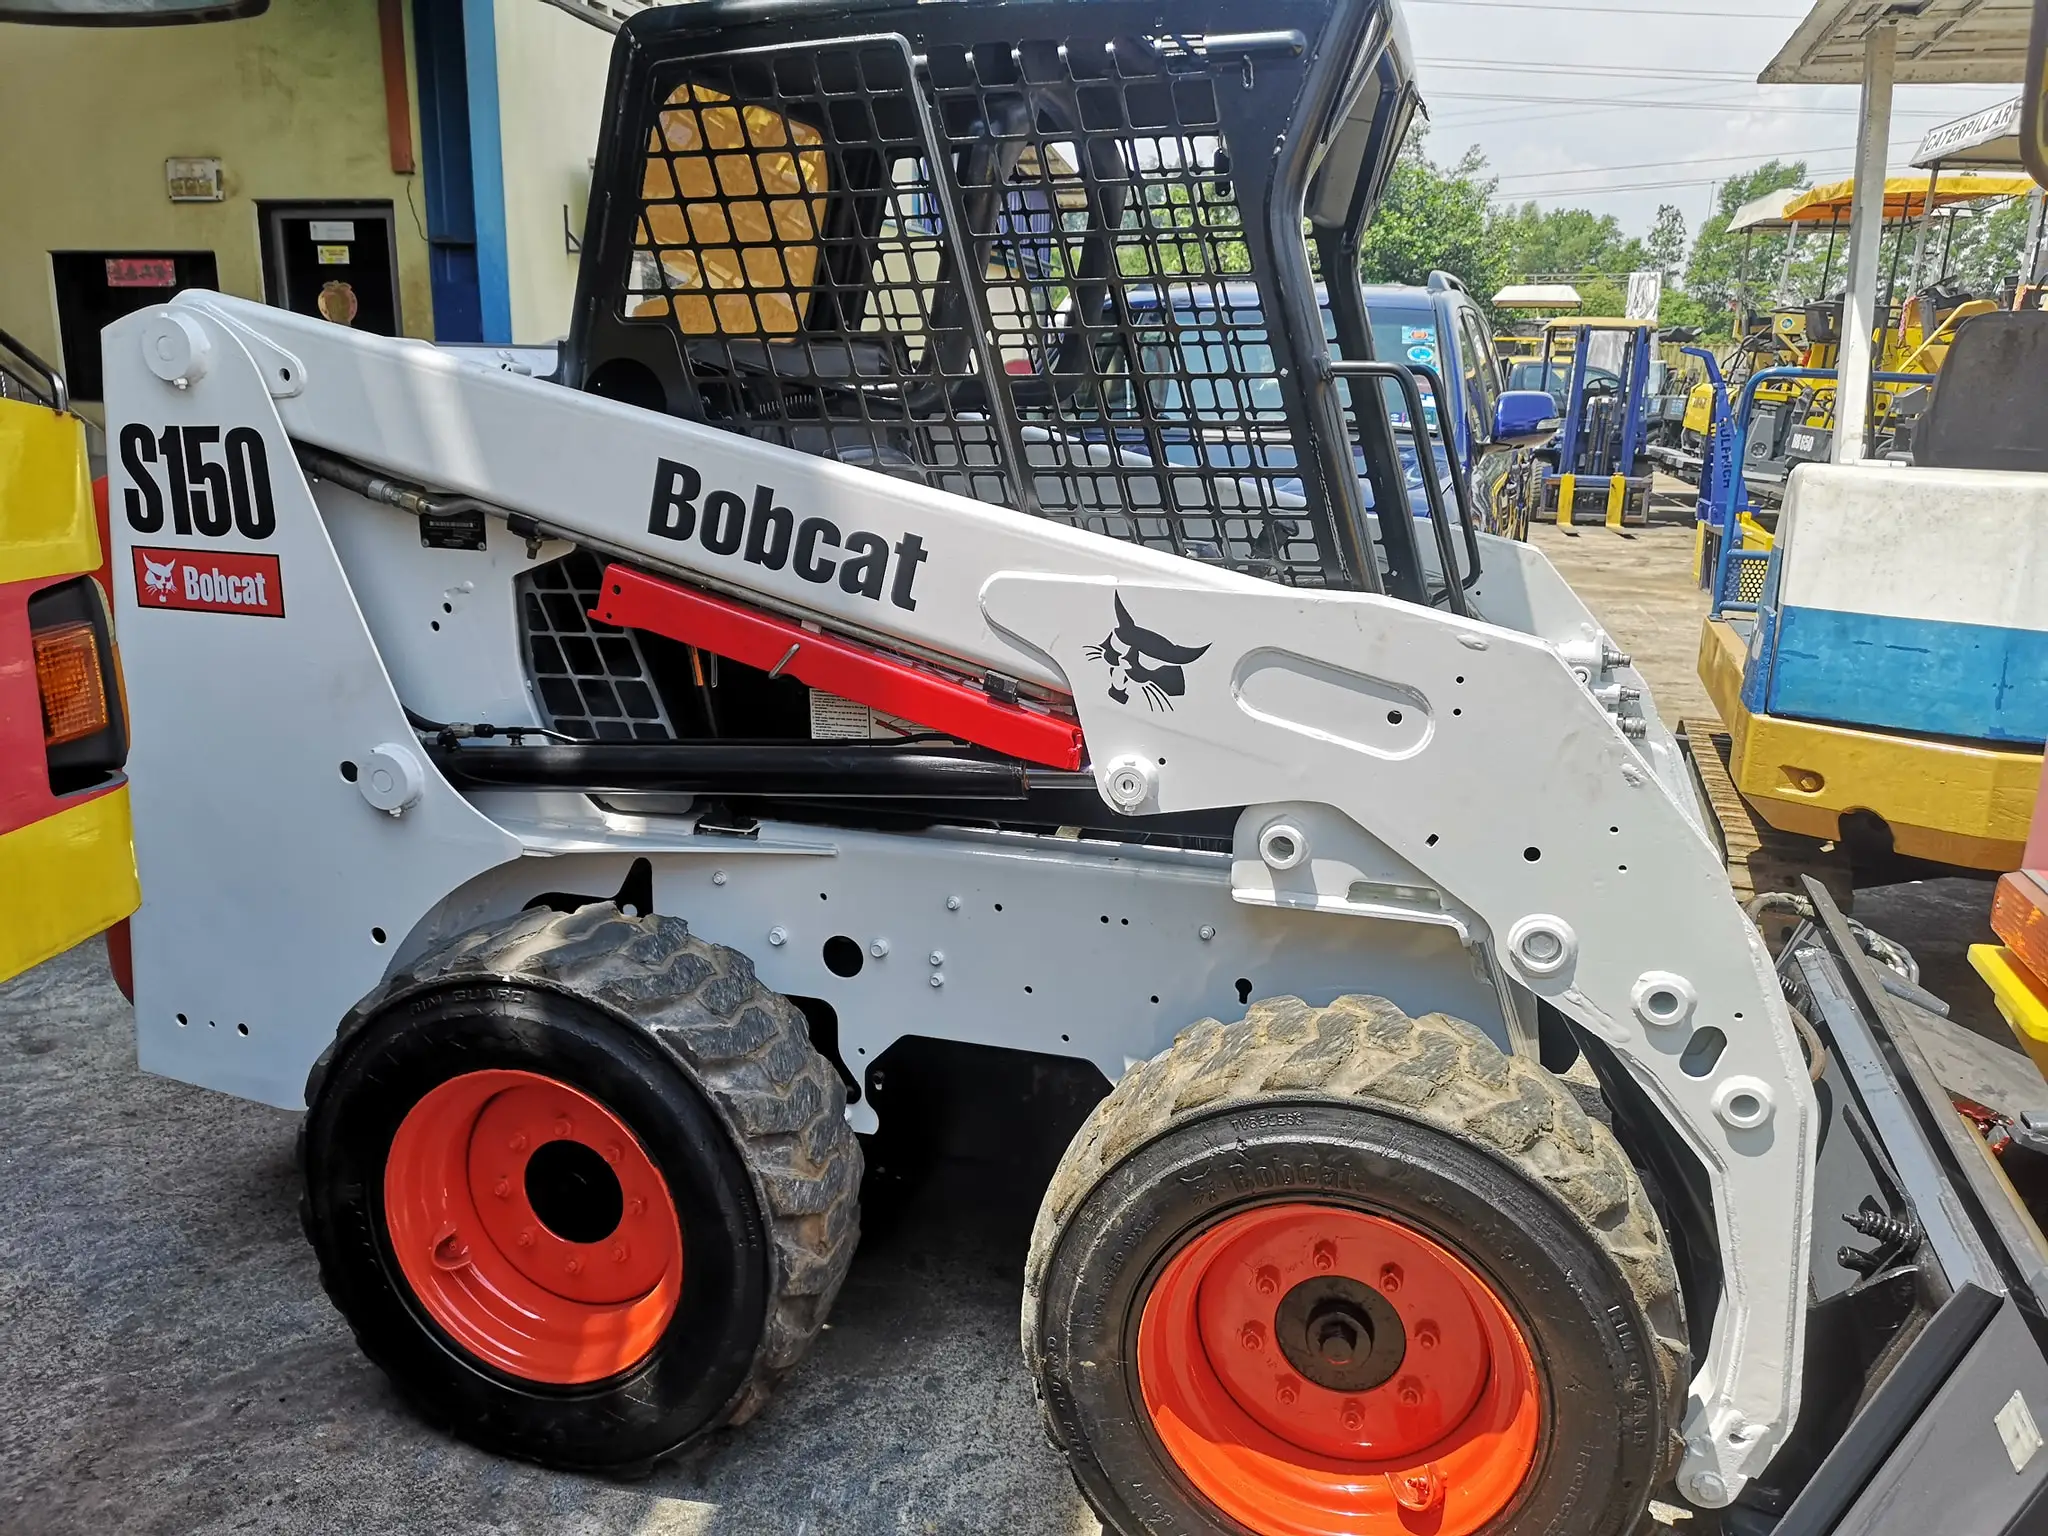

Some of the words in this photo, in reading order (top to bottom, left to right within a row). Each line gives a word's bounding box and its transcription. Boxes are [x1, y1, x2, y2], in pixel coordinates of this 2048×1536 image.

[1924, 105, 2013, 152] CATERPILLAR
[119, 423, 276, 540] S150
[648, 457, 928, 612] Bobcat
[183, 565, 267, 606] Bobcat
